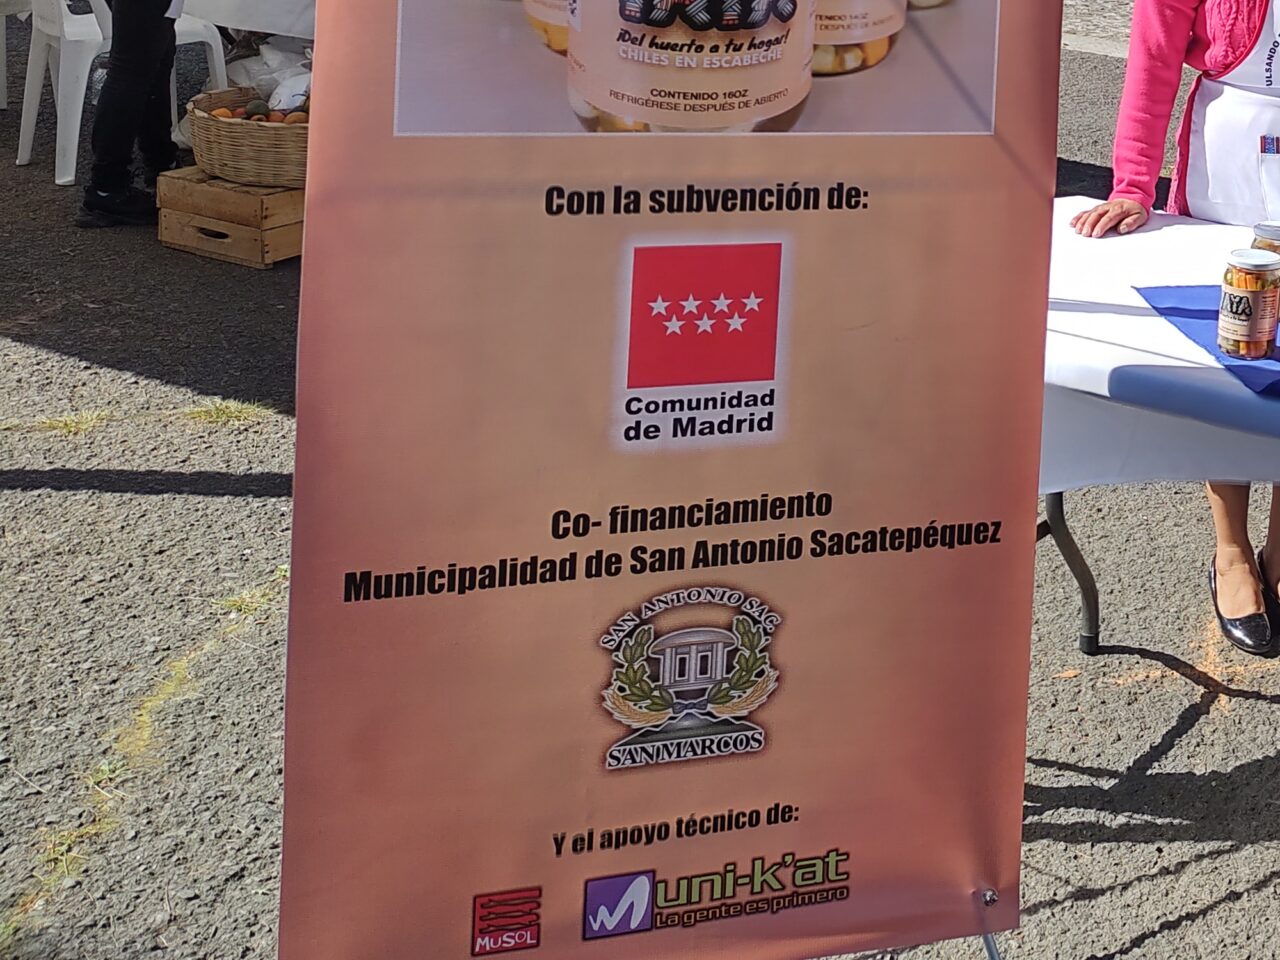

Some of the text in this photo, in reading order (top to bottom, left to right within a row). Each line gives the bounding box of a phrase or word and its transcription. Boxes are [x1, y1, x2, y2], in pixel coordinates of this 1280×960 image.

[648, 34, 707, 54] huerto
[709, 43, 721, 54] a
[724, 38, 743, 53] tu
[747, 28, 790, 52] hogar!
[618, 46, 784, 68] CHILES EN ESCABECHE
[650, 88, 719, 101] CONTENIDO
[683, 101, 736, 113] DESPUÉS
[738, 99, 752, 109] DE
[753, 88, 789, 107] ABIERTO
[544, 182, 868, 216] Con la subvención de:
[624, 389, 775, 416] Comunidad
[623, 412, 774, 441] de Madrid
[551, 491, 833, 540] Co- financiamiento
[343, 520, 1002, 603] Municipalidad de San Antonio Sacatepéquez
[601, 612, 640, 648] SAN
[641, 587, 743, 618] ANTONIO
[553, 801, 800, 857] Y el apoyo técnico de:
[655, 887, 849, 929] La gente es primero
